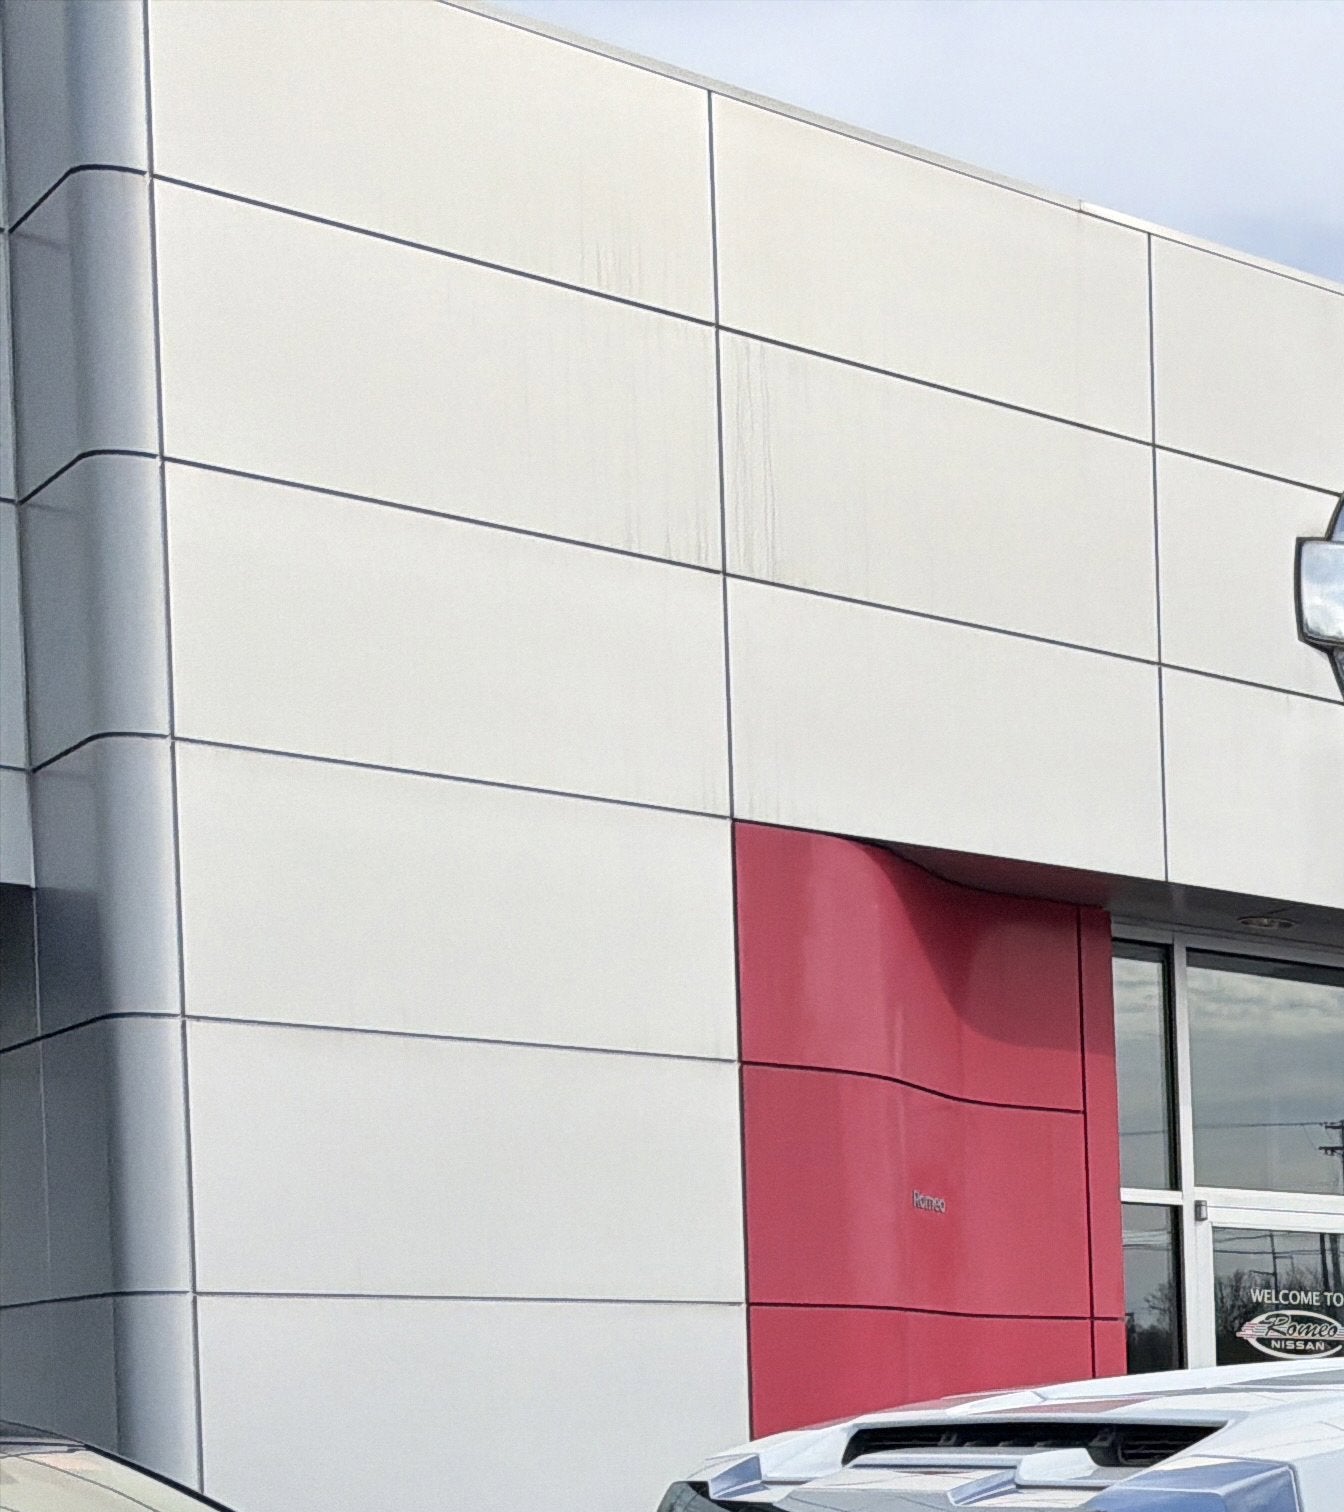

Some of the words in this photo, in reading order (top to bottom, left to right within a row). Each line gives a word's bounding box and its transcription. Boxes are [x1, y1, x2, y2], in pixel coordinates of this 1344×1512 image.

[1250, 1288, 1321, 1306] WELCOME
[1323, 1292, 1344, 1307] TO
[1258, 1313, 1339, 1337] Romeo
[1271, 1340, 1325, 1351] NISSAN
